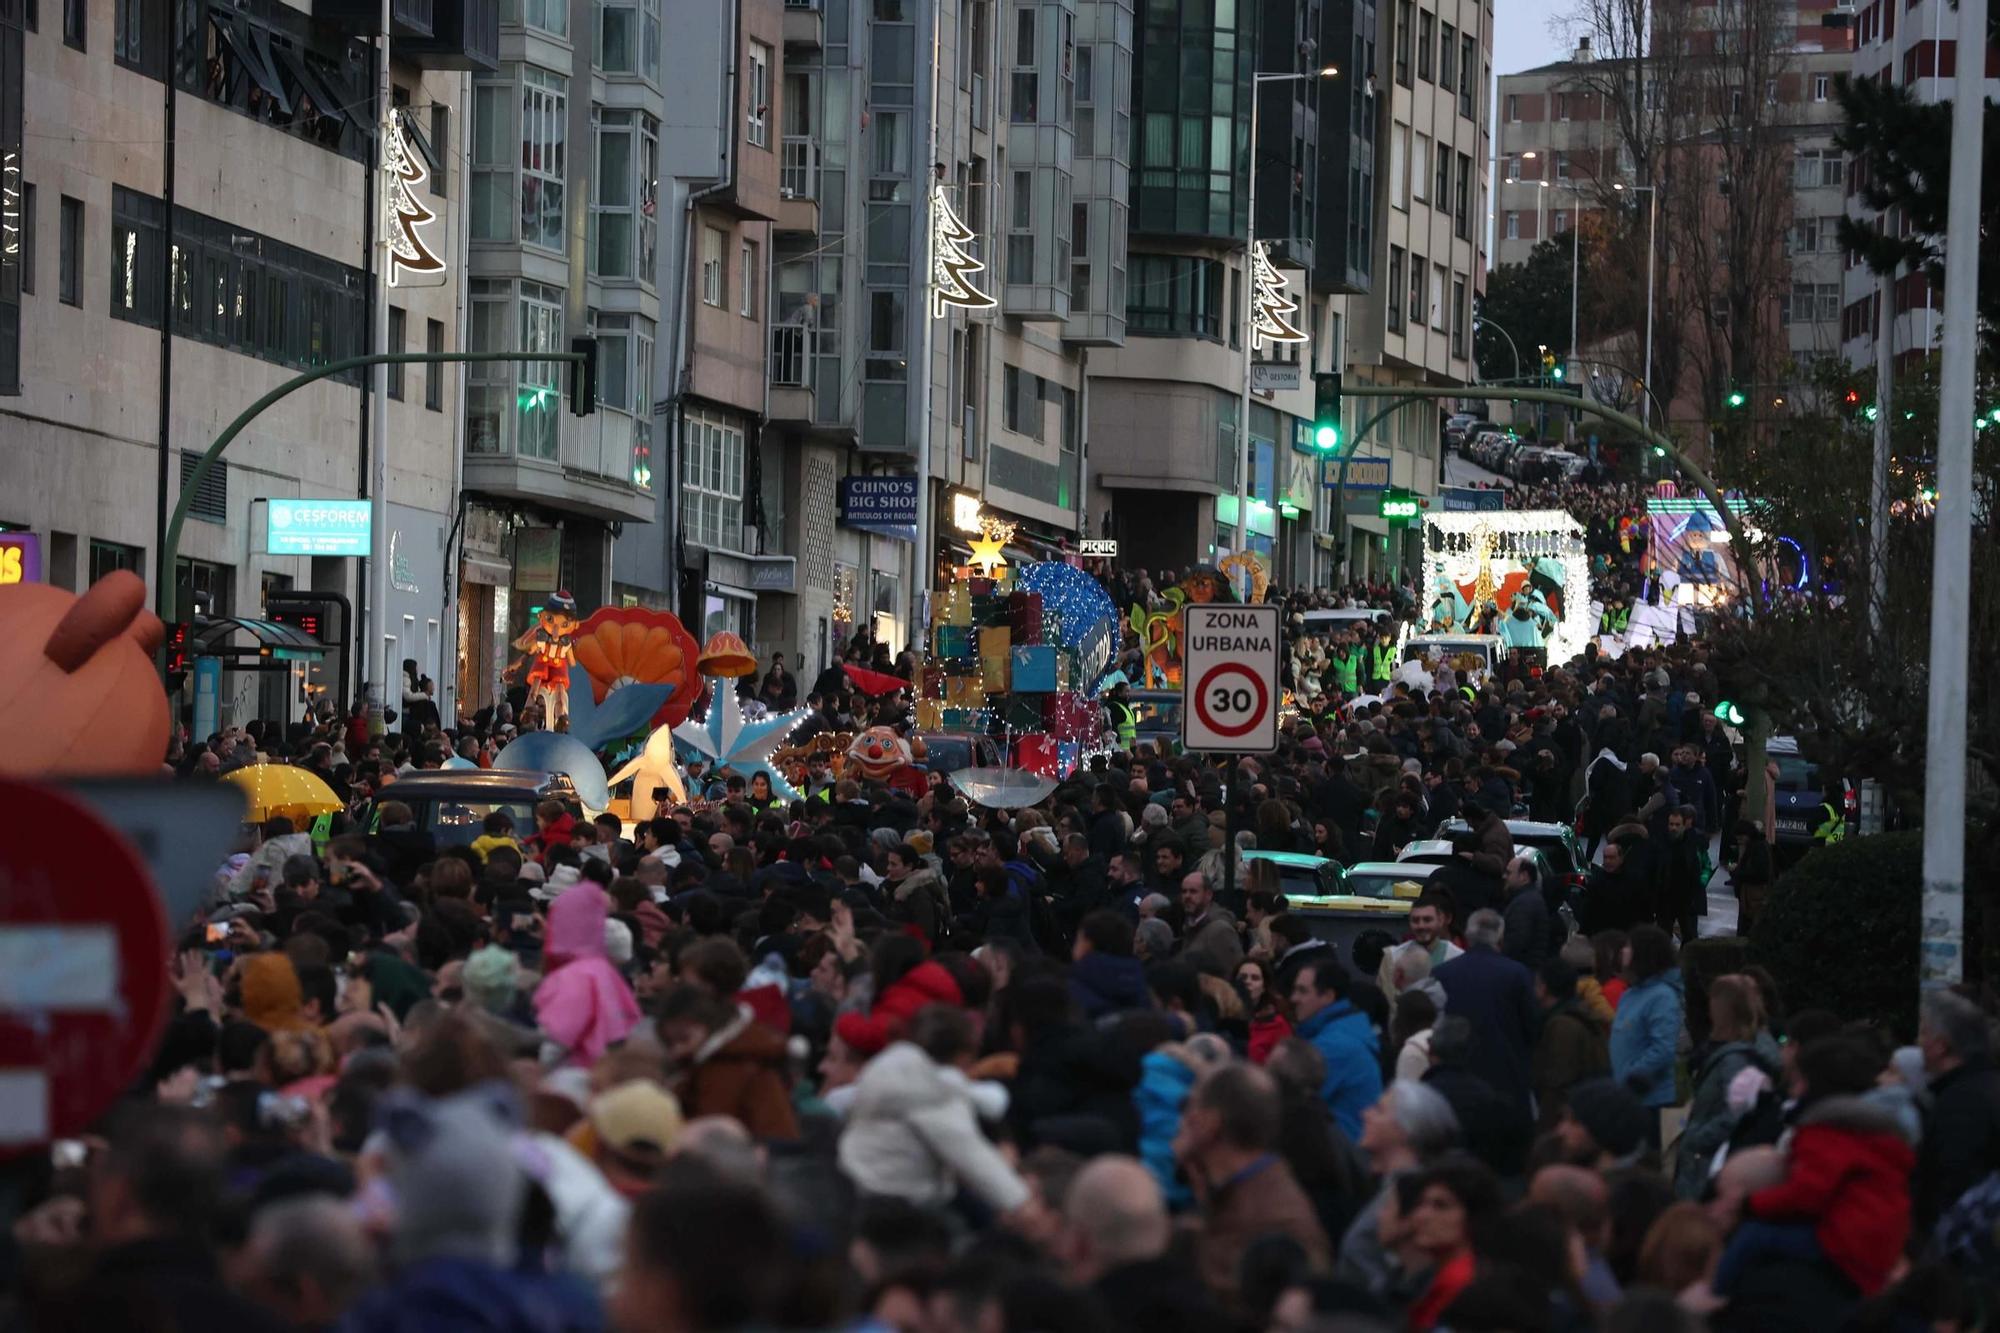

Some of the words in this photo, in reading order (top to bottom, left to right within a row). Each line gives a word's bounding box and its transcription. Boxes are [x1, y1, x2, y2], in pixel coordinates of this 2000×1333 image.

[851, 481, 913, 493] CHINO'S
[849, 496, 875, 507] BIG
[294, 509, 369, 522] CESFOREM
[883, 512, 892, 520] DE
[1082, 542, 1115, 553] PICNIC
[1205, 613, 1259, 629] ZONA
[1192, 636, 1272, 652] URBANA
[1212, 688, 1251, 713] 30
